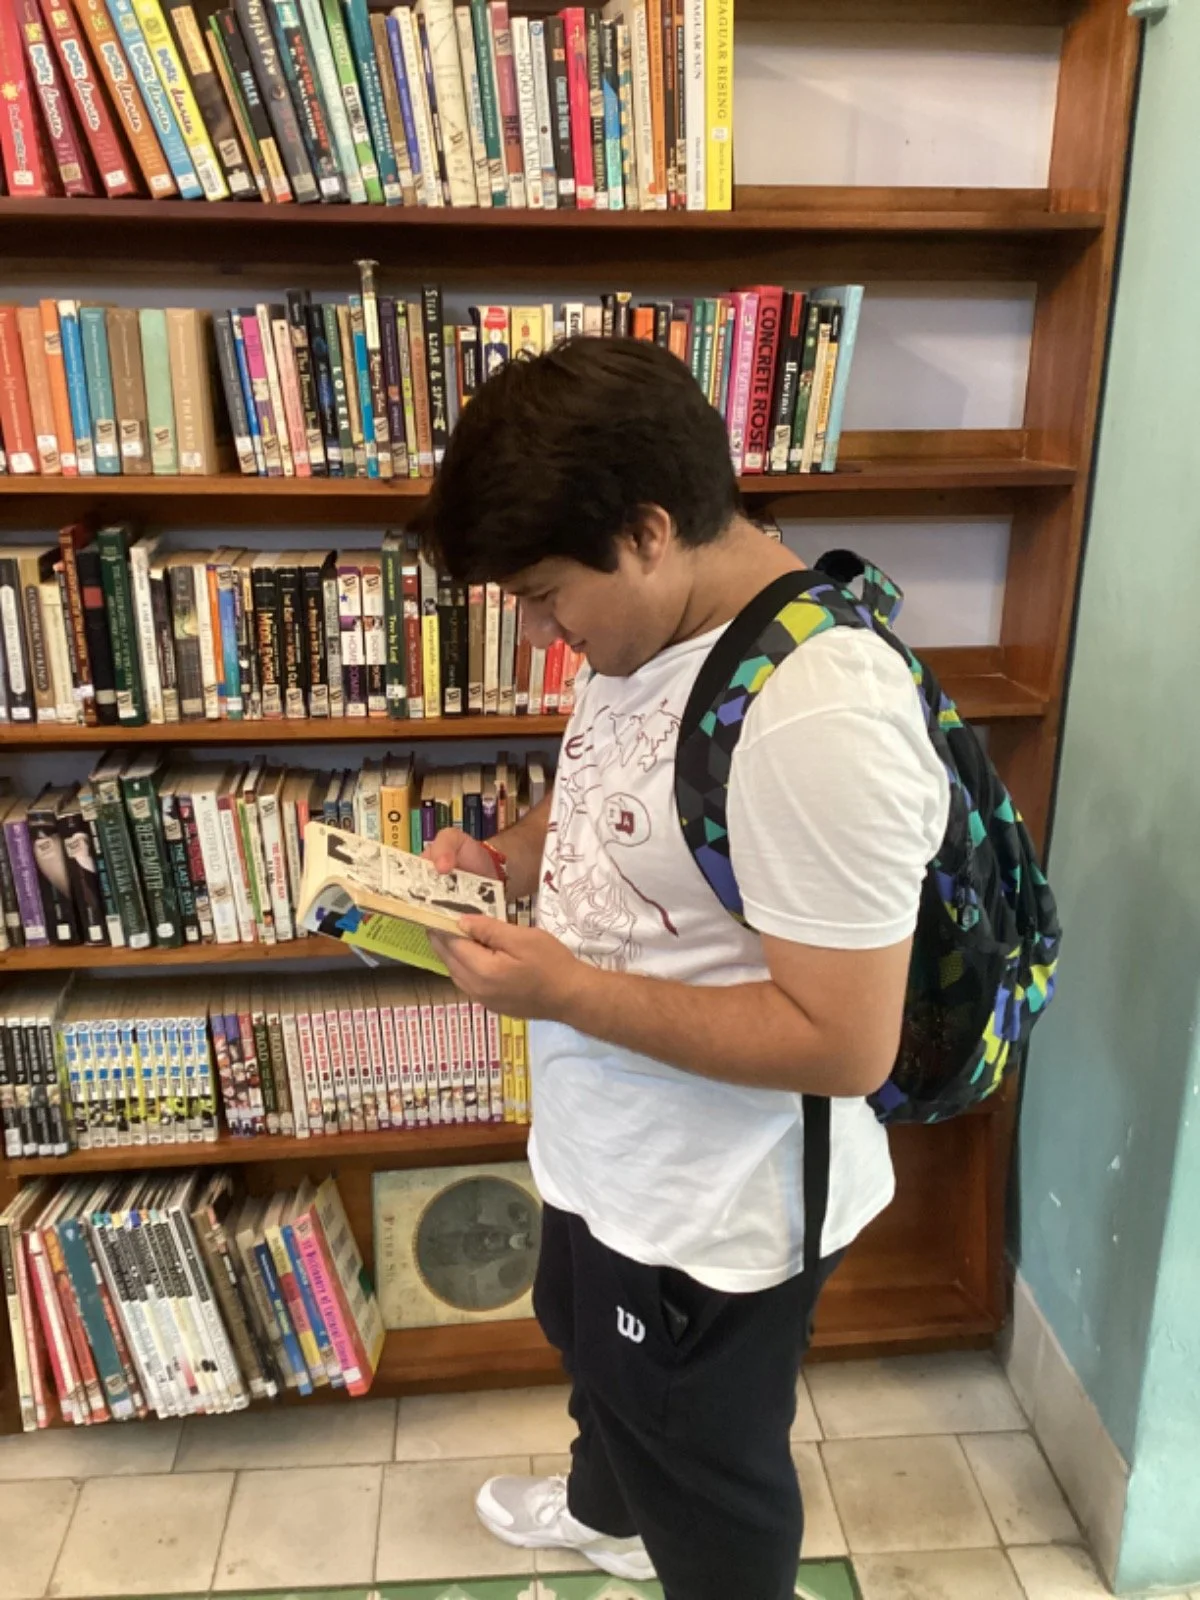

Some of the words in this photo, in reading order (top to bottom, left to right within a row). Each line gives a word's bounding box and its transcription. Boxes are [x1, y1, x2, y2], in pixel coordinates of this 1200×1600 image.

[754, 307, 778, 395] CONCRETE
[333, 366, 349, 431] LOSER
[748, 399, 768, 452] ROSE
[258, 613, 275, 685] MIDDLEWORL
[136, 822, 163, 890] BEHEMOTH
